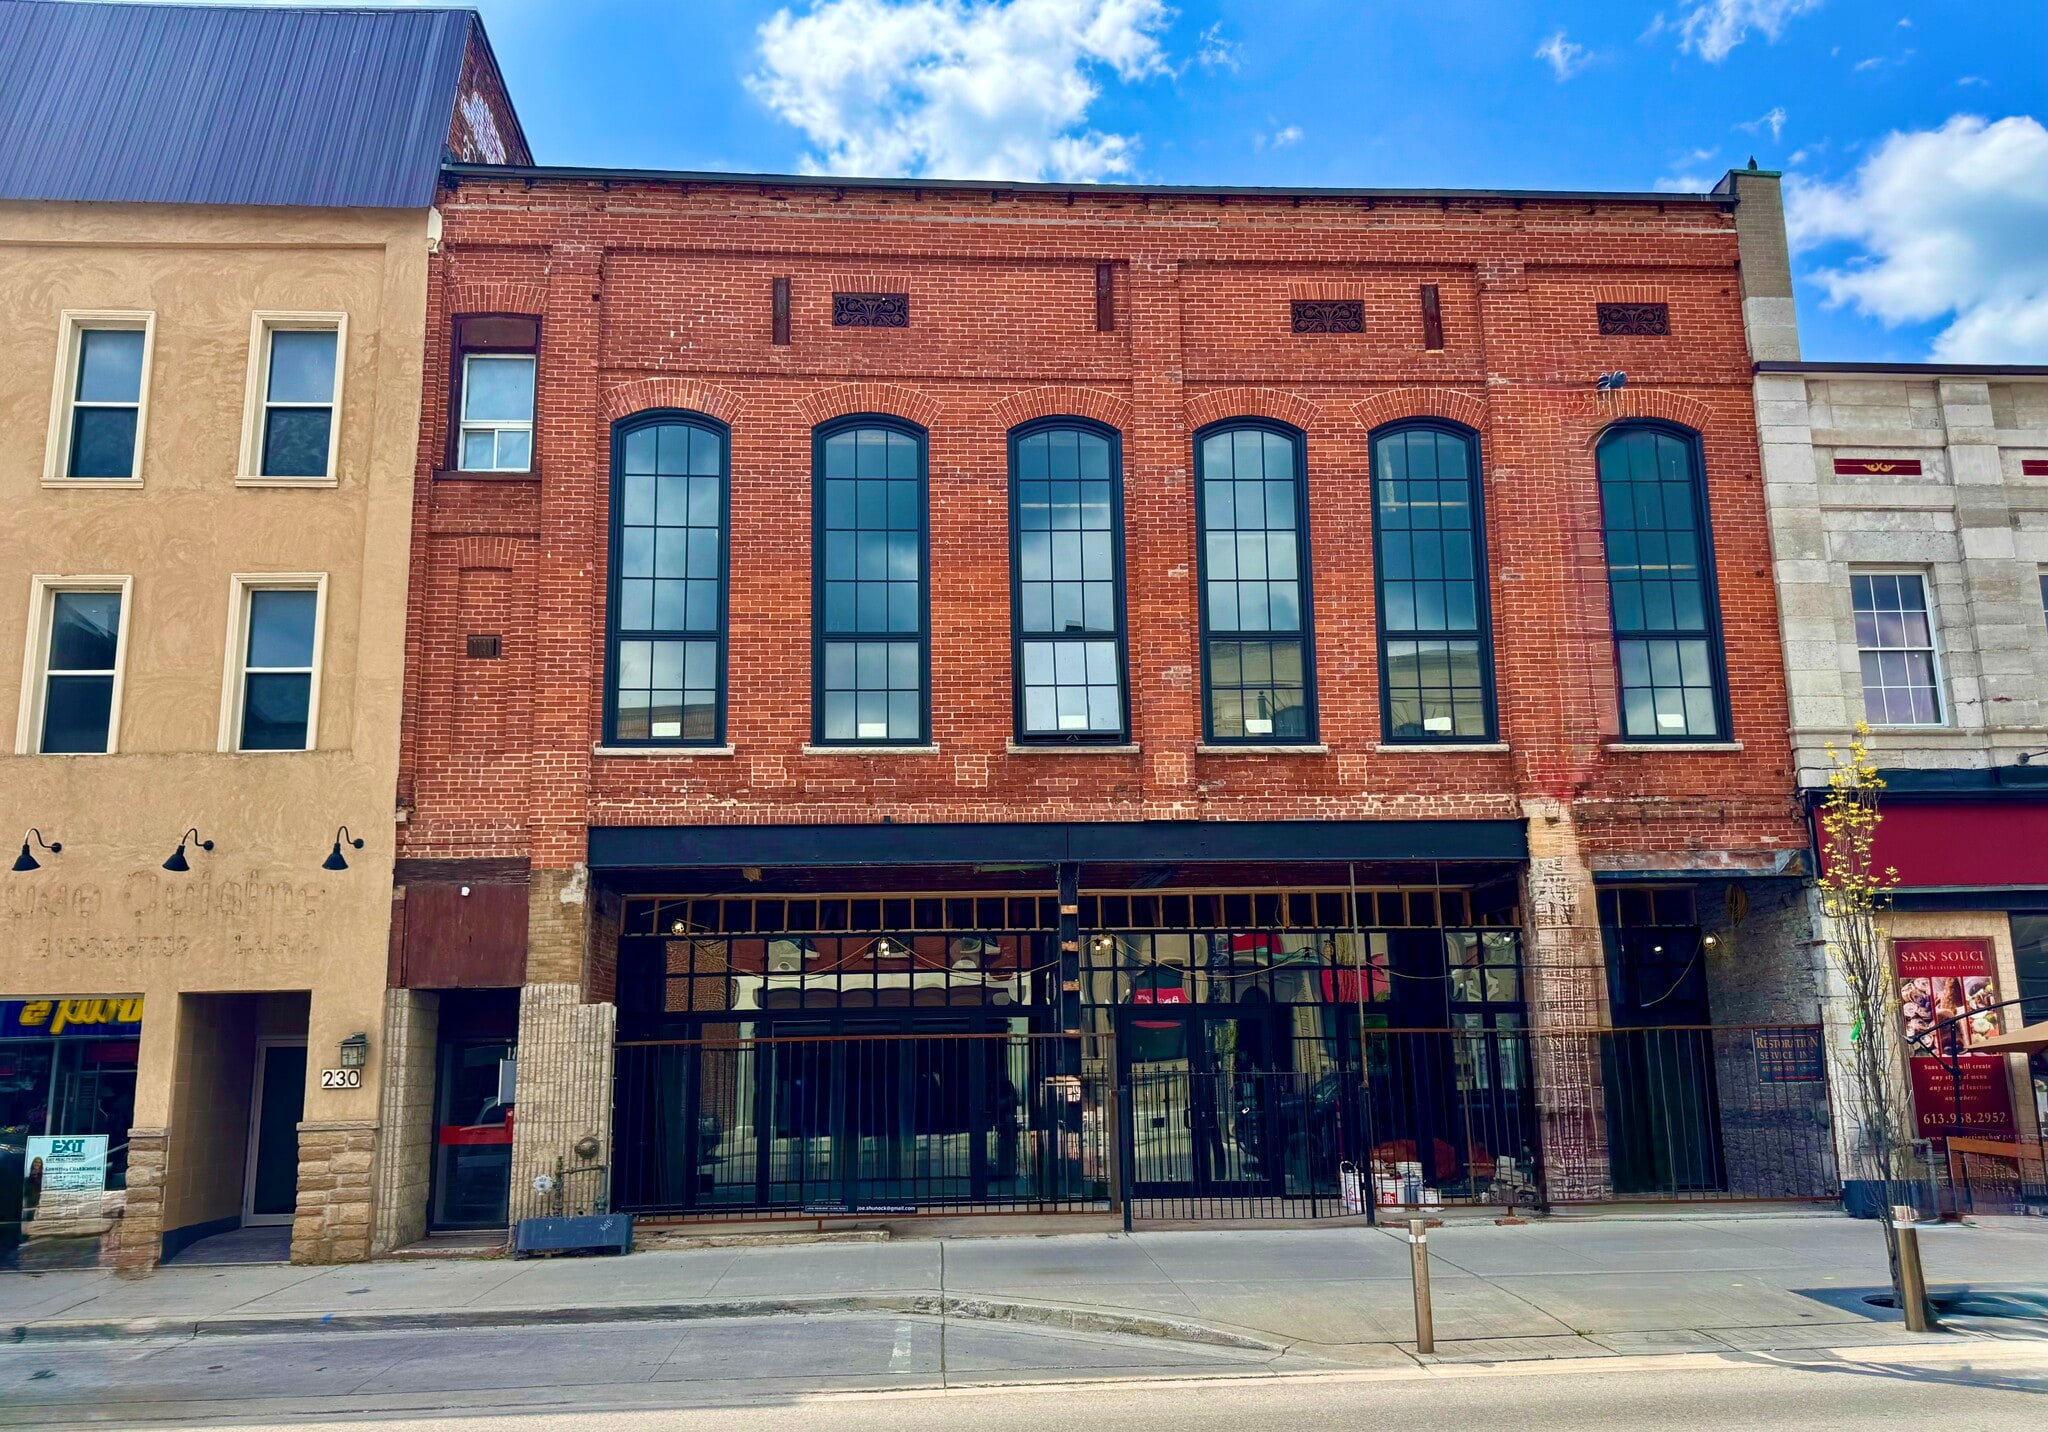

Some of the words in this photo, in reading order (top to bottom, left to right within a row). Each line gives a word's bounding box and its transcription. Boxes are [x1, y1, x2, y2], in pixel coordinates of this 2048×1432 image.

[1901, 952, 1936, 962] SANS
[1941, 950, 1984, 962] SOUCI
[323, 1070, 360, 1087] 230
